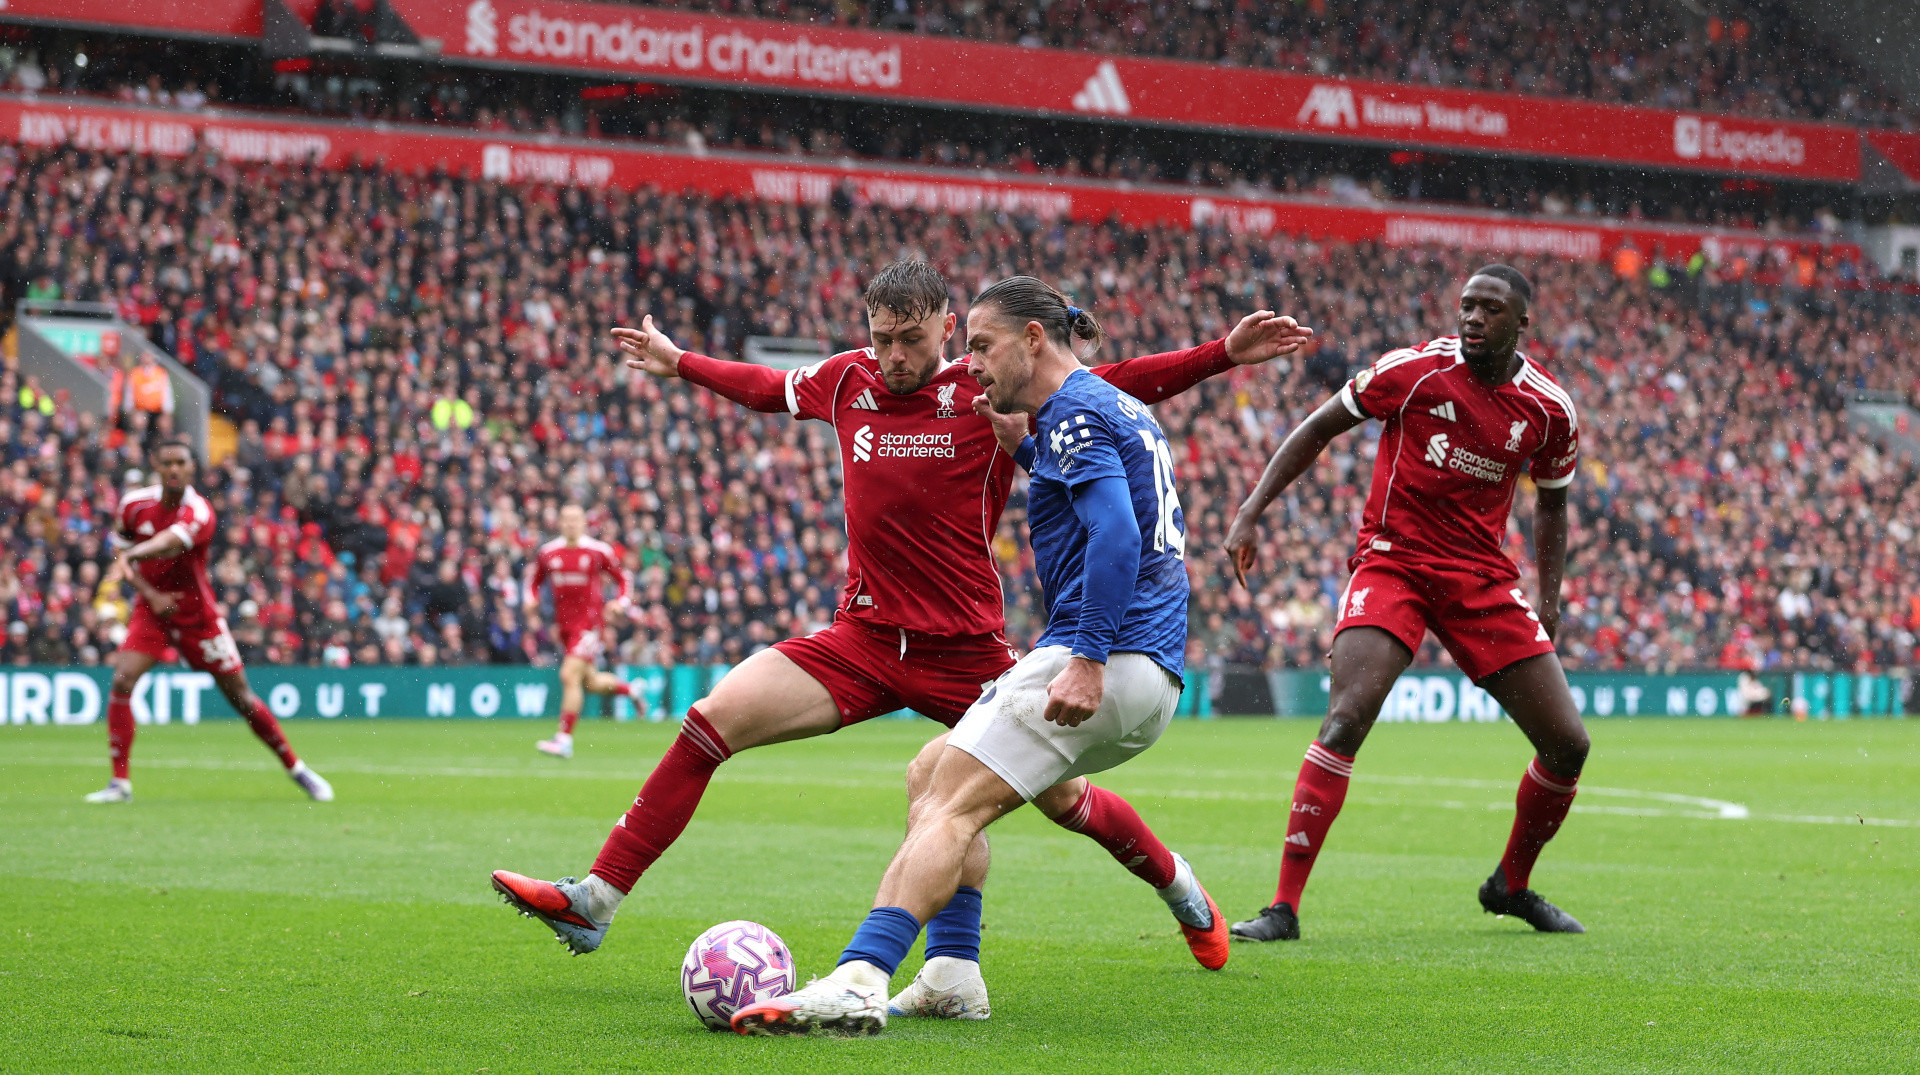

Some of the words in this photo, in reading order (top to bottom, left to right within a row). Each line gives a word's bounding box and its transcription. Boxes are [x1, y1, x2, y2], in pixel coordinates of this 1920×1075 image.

[508, 11, 702, 70] standard
[707, 31, 901, 89] chartered
[1297, 84, 1358, 129] AXA
[1703, 121, 1805, 166] Expedia
[877, 445, 955, 458] chartered
[879, 432, 952, 445] standard
[1449, 458, 1504, 482] chartered
[1452, 446, 1507, 472] standard
[1138, 430, 1185, 561] 18
[269, 683, 387, 718] OUT
[426, 682, 549, 718] NOW
[1291, 801, 1322, 816] LFC
